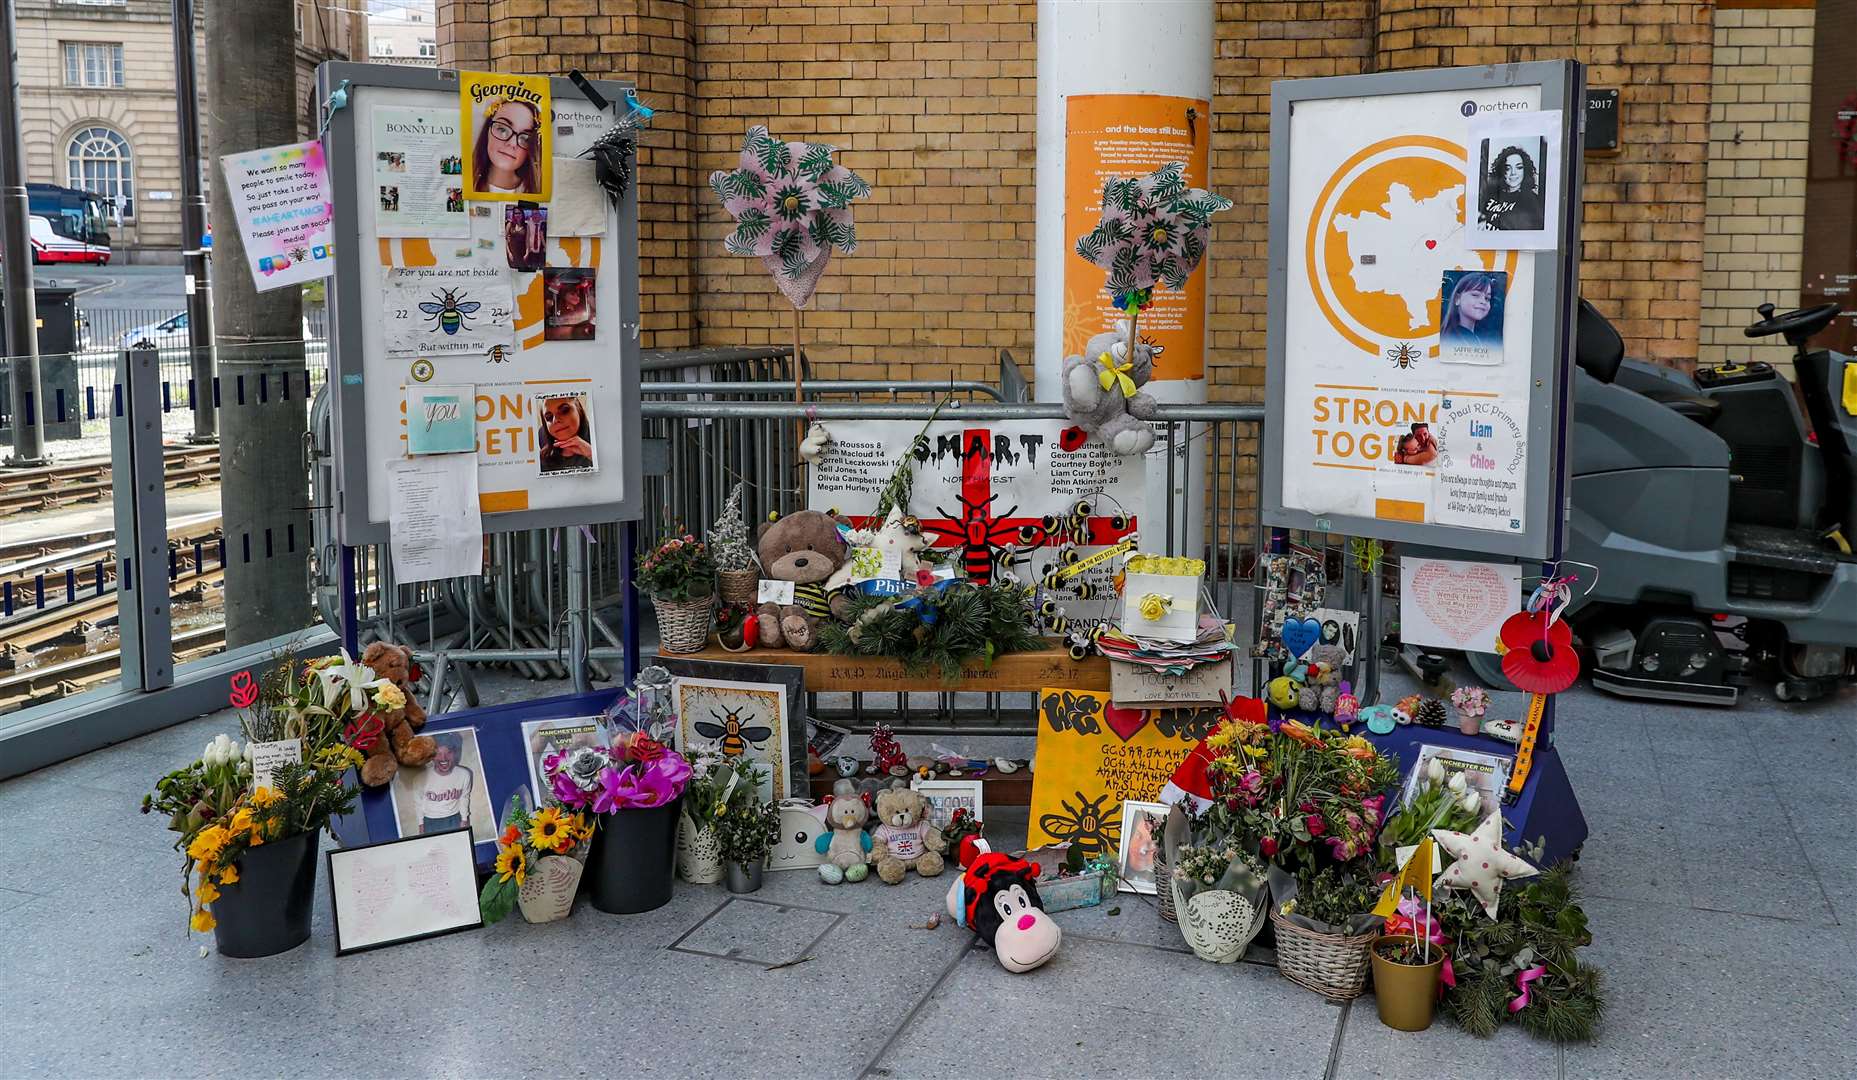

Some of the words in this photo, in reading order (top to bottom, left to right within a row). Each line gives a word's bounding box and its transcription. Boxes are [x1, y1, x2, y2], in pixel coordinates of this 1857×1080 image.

[470, 80, 542, 104] Georgina
[1479, 101, 1528, 112] northern
[1589, 99, 1612, 109] 2017
[557, 112, 603, 122] northern
[386, 123, 429, 134] BONNY
[431, 126, 454, 136] LAD
[1105, 125, 1121, 133] and
[1124, 124, 1137, 133] the
[1138, 125, 1157, 134] bees
[246, 168, 260, 177] We
[260, 166, 277, 175] want
[289, 161, 307, 169] many
[241, 180, 264, 191] people
[275, 174, 293, 183] smile
[246, 193, 255, 201] So
[257, 191, 271, 200] just
[273, 188, 289, 196] take
[248, 205, 260, 214] you
[262, 201, 278, 210] pass
[289, 197, 304, 206] your
[252, 230, 275, 239] Please
[276, 227, 290, 236] join
[418, 269, 435, 280] you
[455, 268, 470, 276] not
[473, 267, 499, 277] beside
[395, 309, 408, 319] 22
[425, 400, 458, 432] you
[1470, 420, 1492, 438] Liam
[1449, 404, 1471, 423] Paul
[1473, 403, 1490, 414] RC
[1490, 405, 1522, 440] Primary
[1506, 440, 1527, 475] School
[841, 441, 875, 449] Roussos
[876, 441, 882, 449] 8
[1476, 442, 1482, 451] &
[841, 449, 873, 457] Macloud
[1050, 451, 1087, 460] Georgina
[844, 458, 889, 467] Leczkowski
[1050, 460, 1087, 469] Courtney
[1089, 460, 1112, 469] Boyle
[1470, 454, 1495, 470] Chloe
[817, 465, 833, 473] Nell
[834, 466, 857, 474] Jones
[841, 475, 877, 485] Campbell
[1072, 477, 1107, 485] Atkinson
[817, 483, 844, 493] Megan
[845, 484, 870, 493] Hurley
[871, 486, 881, 494] 15
[1051, 487, 1073, 496] Philip
[1181, 691, 1200, 699] HATE
[1042, 690, 1102, 736] WE
[539, 727, 582, 736] MANCHESTER
[1494, 722, 1512, 732] MCR
[1440, 759, 1479, 770] ANCHESTER
